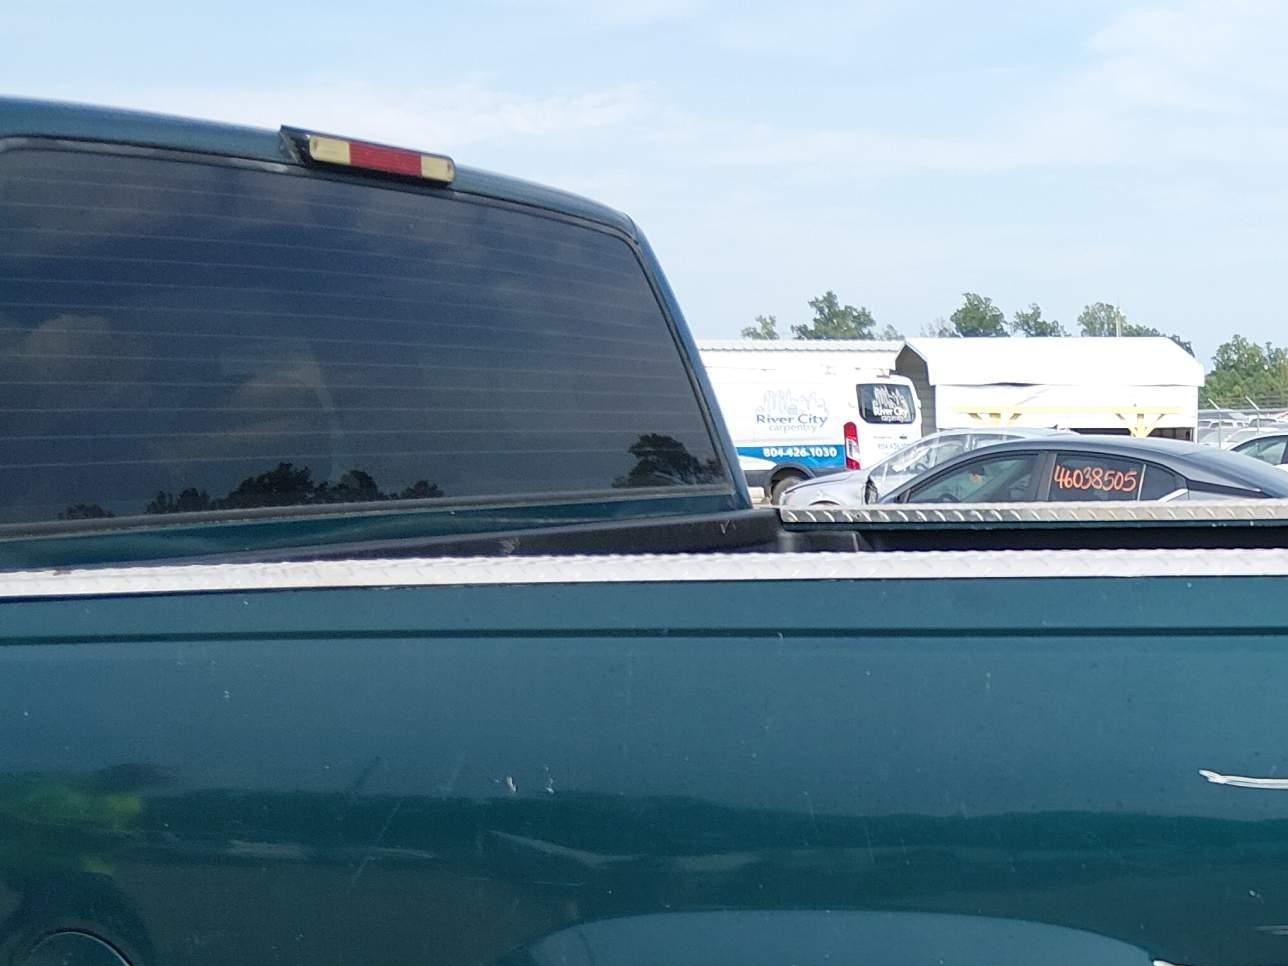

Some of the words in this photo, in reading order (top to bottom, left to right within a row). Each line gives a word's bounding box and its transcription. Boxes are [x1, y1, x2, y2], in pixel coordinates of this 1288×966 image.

[756, 413, 795, 425] River
[797, 413, 829, 428] City
[1054, 464, 1138, 492] 46038505
